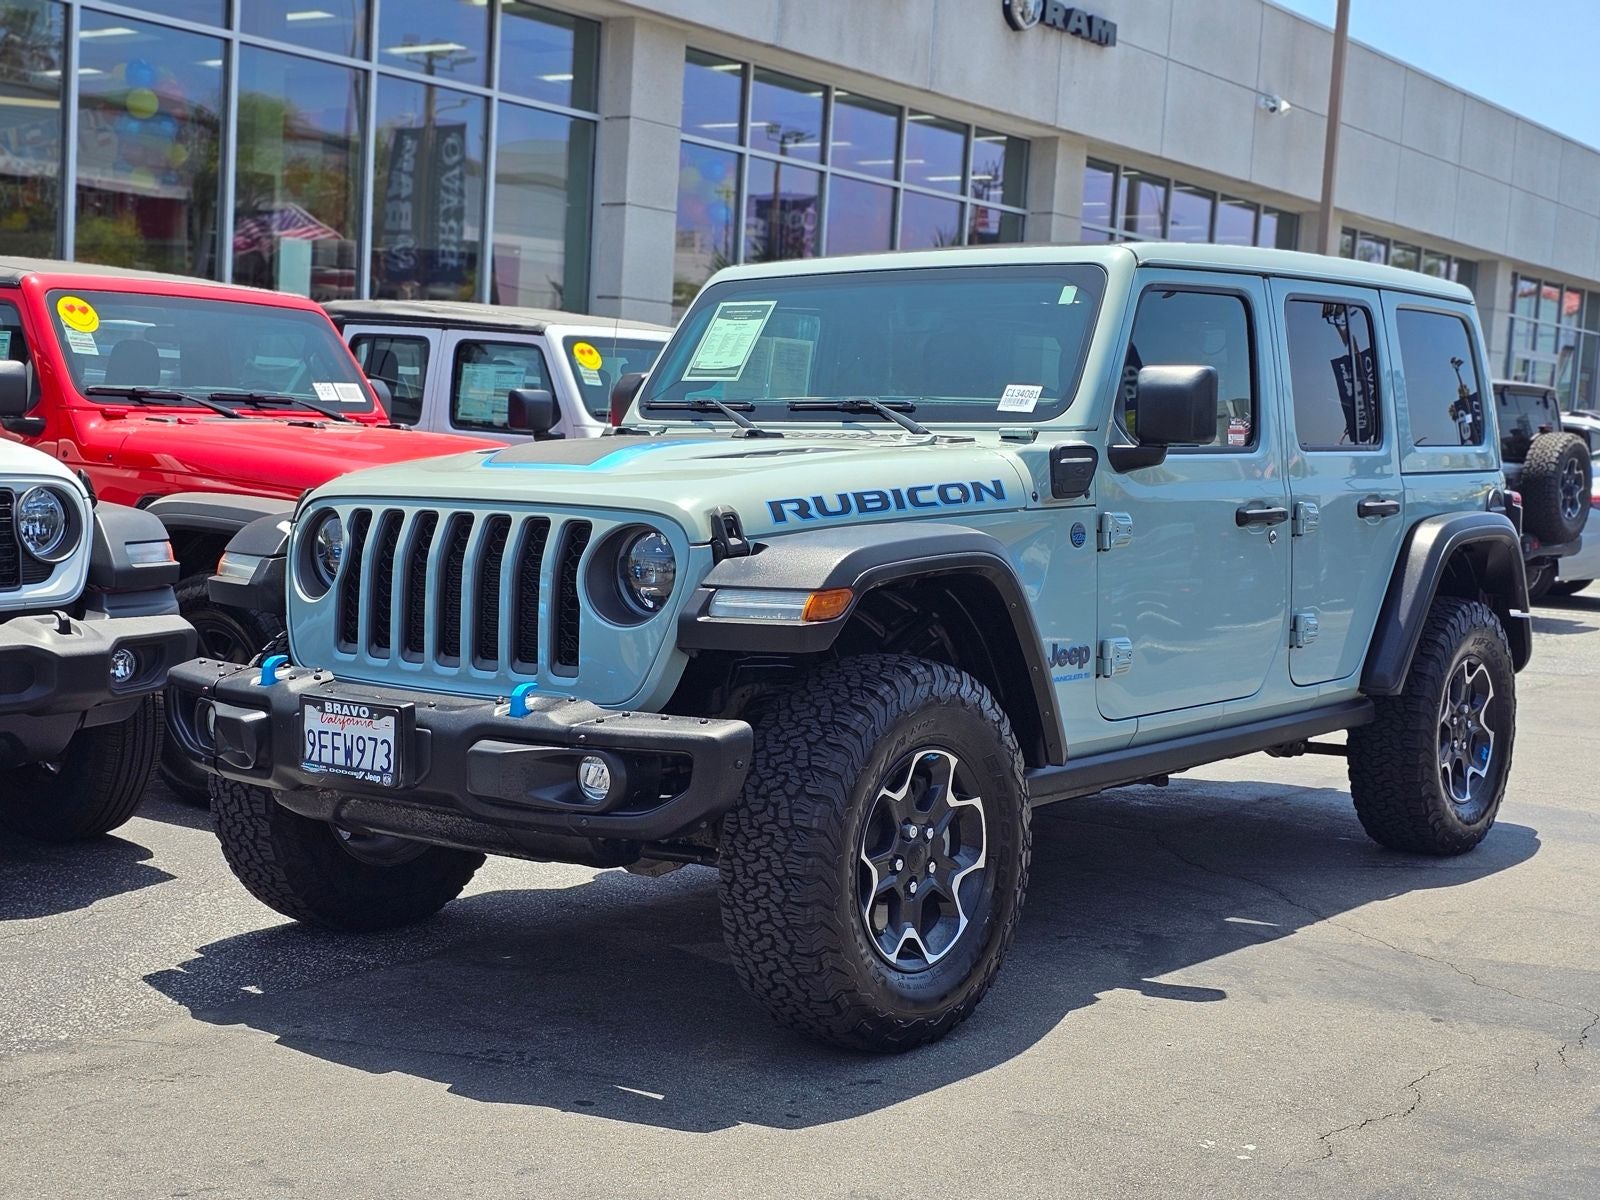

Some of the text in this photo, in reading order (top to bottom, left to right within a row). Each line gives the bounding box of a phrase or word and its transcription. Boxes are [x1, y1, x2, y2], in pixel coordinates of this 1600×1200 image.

[1043, 0, 1117, 46] RAM
[1005, 388, 1039, 399] C134081
[766, 478, 1008, 524] RUBICON
[1048, 642, 1091, 669] Jeep
[320, 712, 380, 730] California
[324, 702, 370, 718] BRAVO
[306, 728, 392, 774] 9FFW973
[365, 772, 381, 783] Jeep
